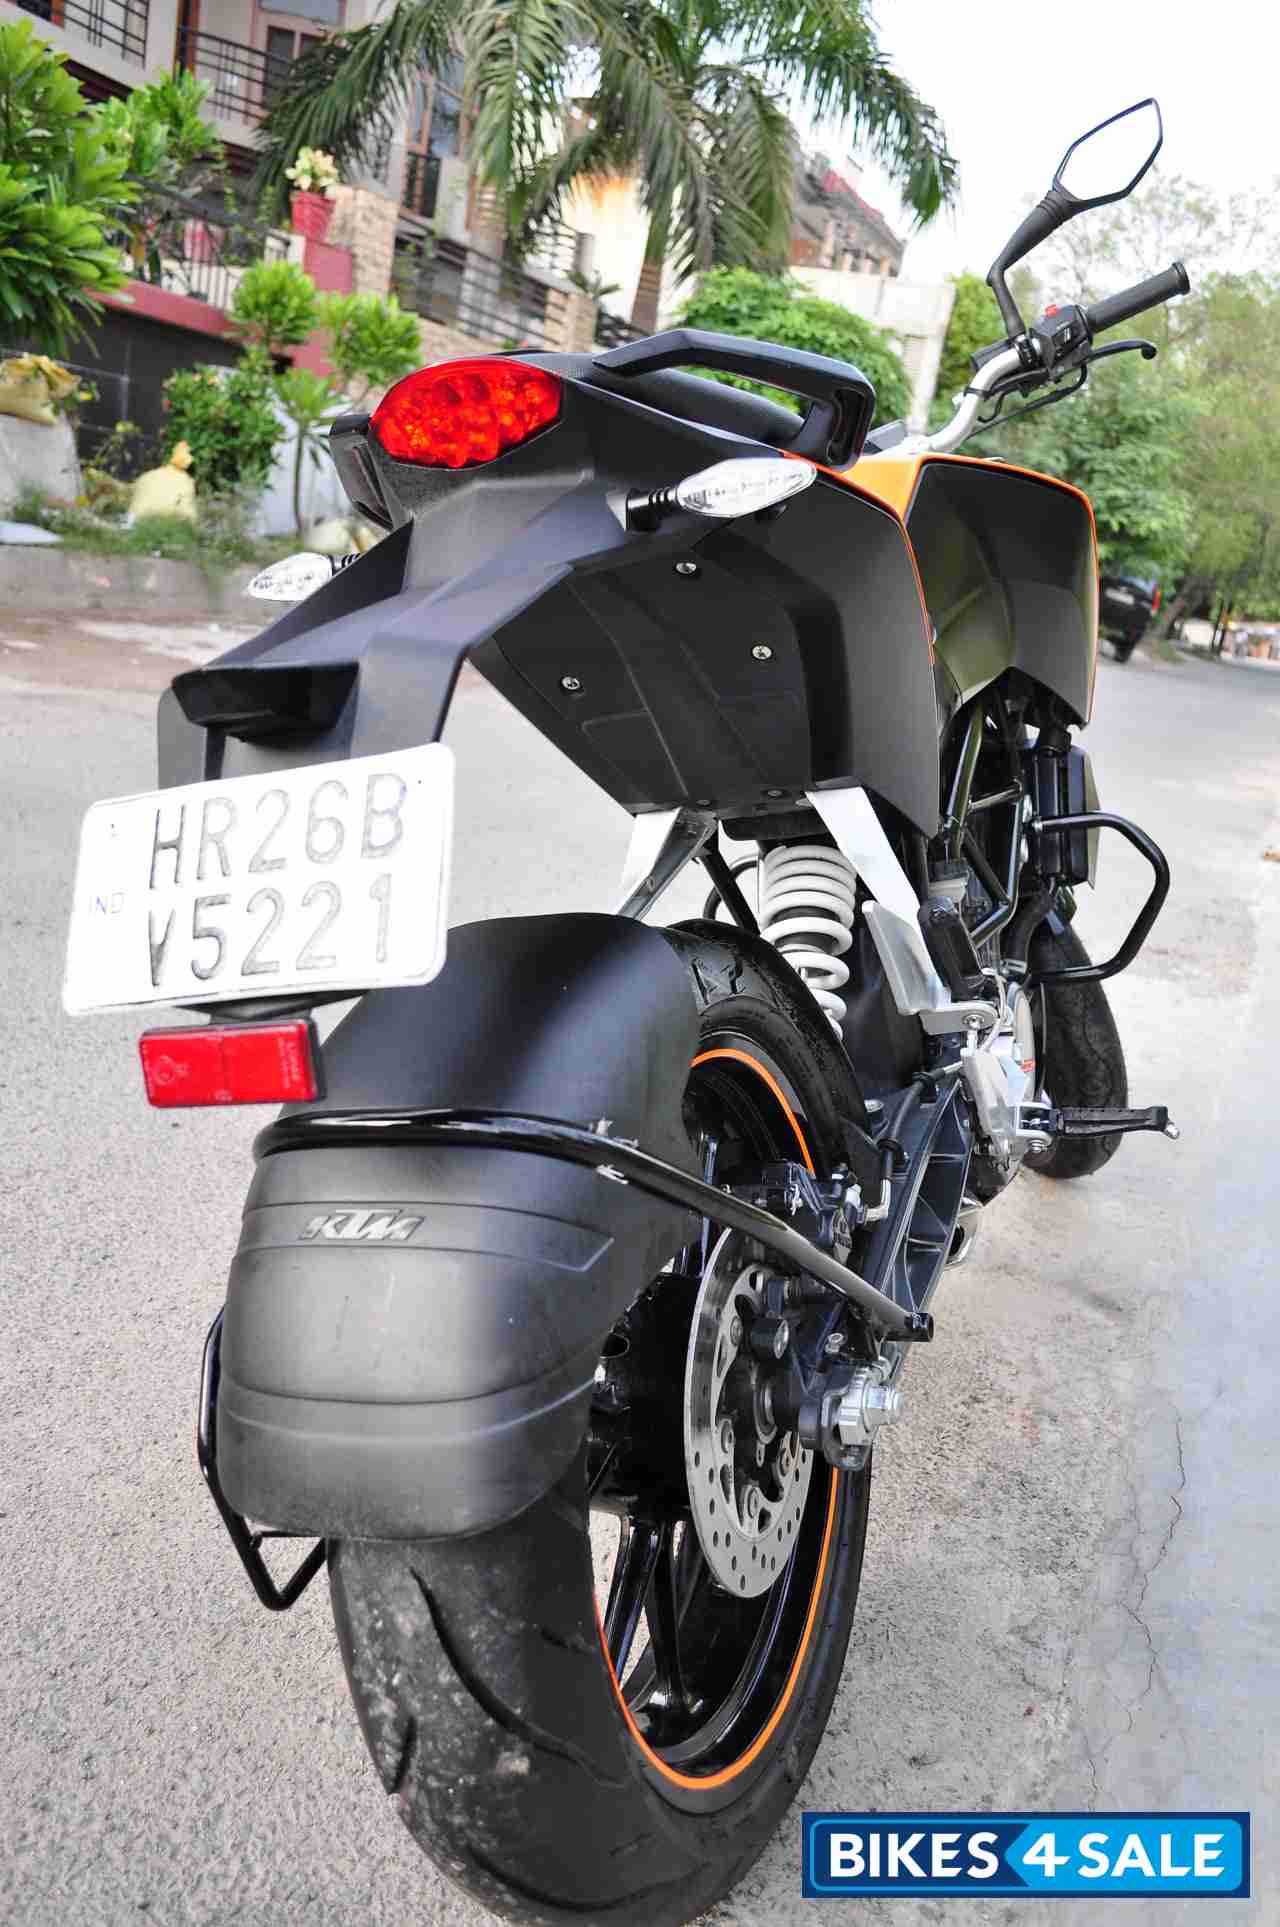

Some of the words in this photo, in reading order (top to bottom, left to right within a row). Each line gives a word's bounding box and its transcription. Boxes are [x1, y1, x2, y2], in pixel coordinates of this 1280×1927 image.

[149, 772, 408, 890] HR26B
[147, 872, 394, 988] V5221
[299, 1208, 425, 1241] KTM
